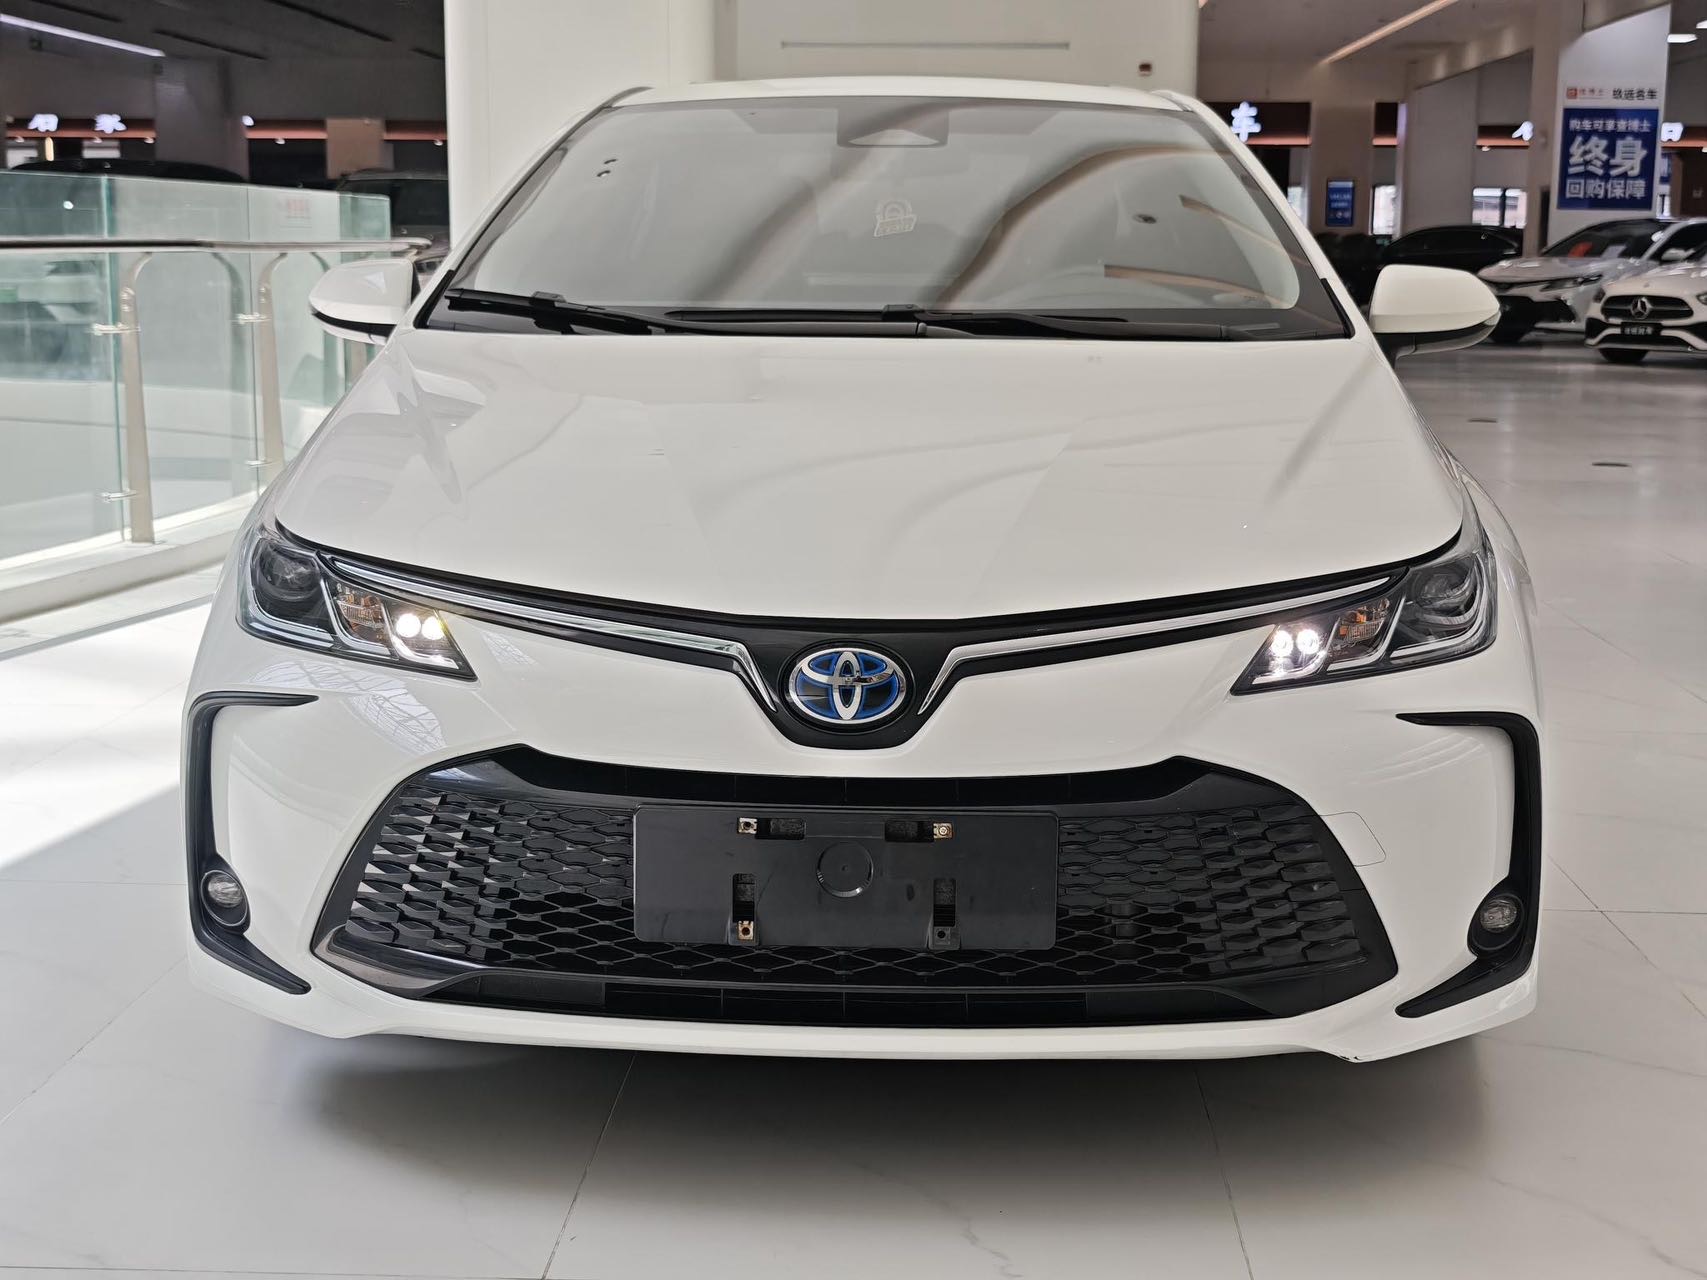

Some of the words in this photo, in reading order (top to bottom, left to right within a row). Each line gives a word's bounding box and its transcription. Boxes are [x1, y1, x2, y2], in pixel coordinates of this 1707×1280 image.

[1567, 136, 1648, 177] 终身
[1565, 179, 1646, 199] 回购保障
